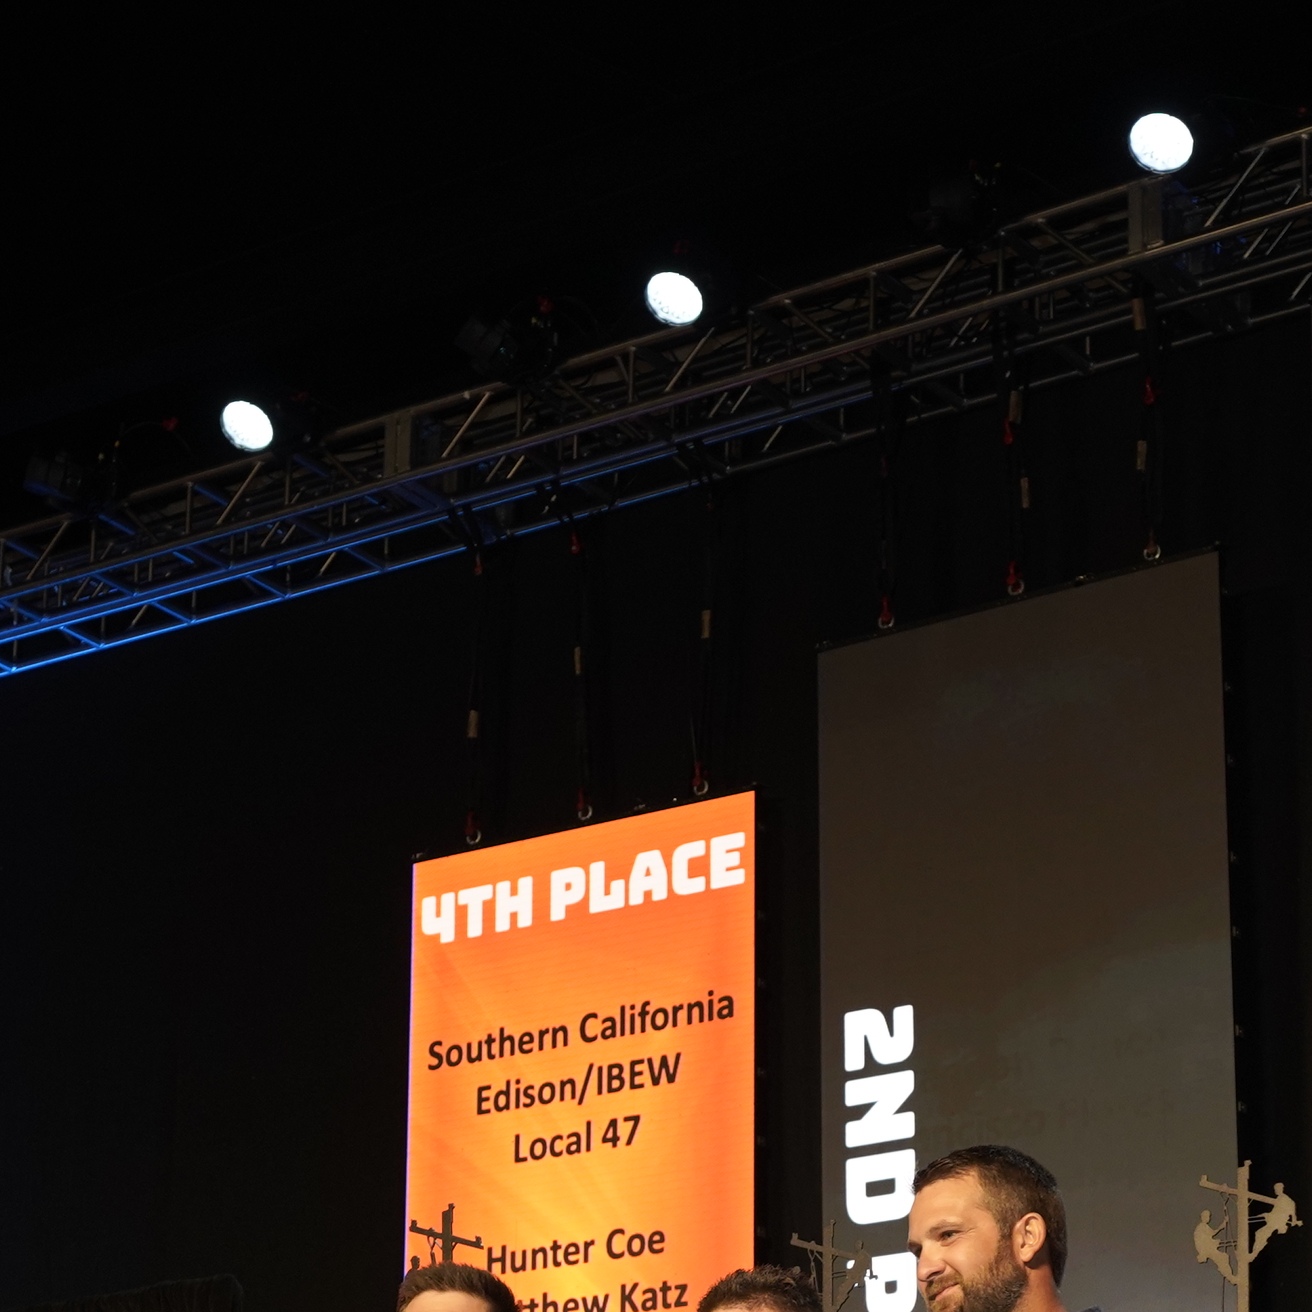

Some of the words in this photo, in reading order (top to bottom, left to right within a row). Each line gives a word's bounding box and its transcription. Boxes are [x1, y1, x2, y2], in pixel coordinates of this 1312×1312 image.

[421, 875, 534, 944] 4TH
[549, 831, 746, 922] PLACE
[427, 1023, 569, 1071] Southern
[579, 990, 735, 1044] California
[476, 1052, 682, 1116] Edison/IBEW
[843, 1004, 917, 1226] 2ND
[514, 1120, 592, 1164] Local
[601, 1114, 642, 1149] 47
[487, 1239, 595, 1275] Hunter
[606, 1228, 666, 1259] Coe
